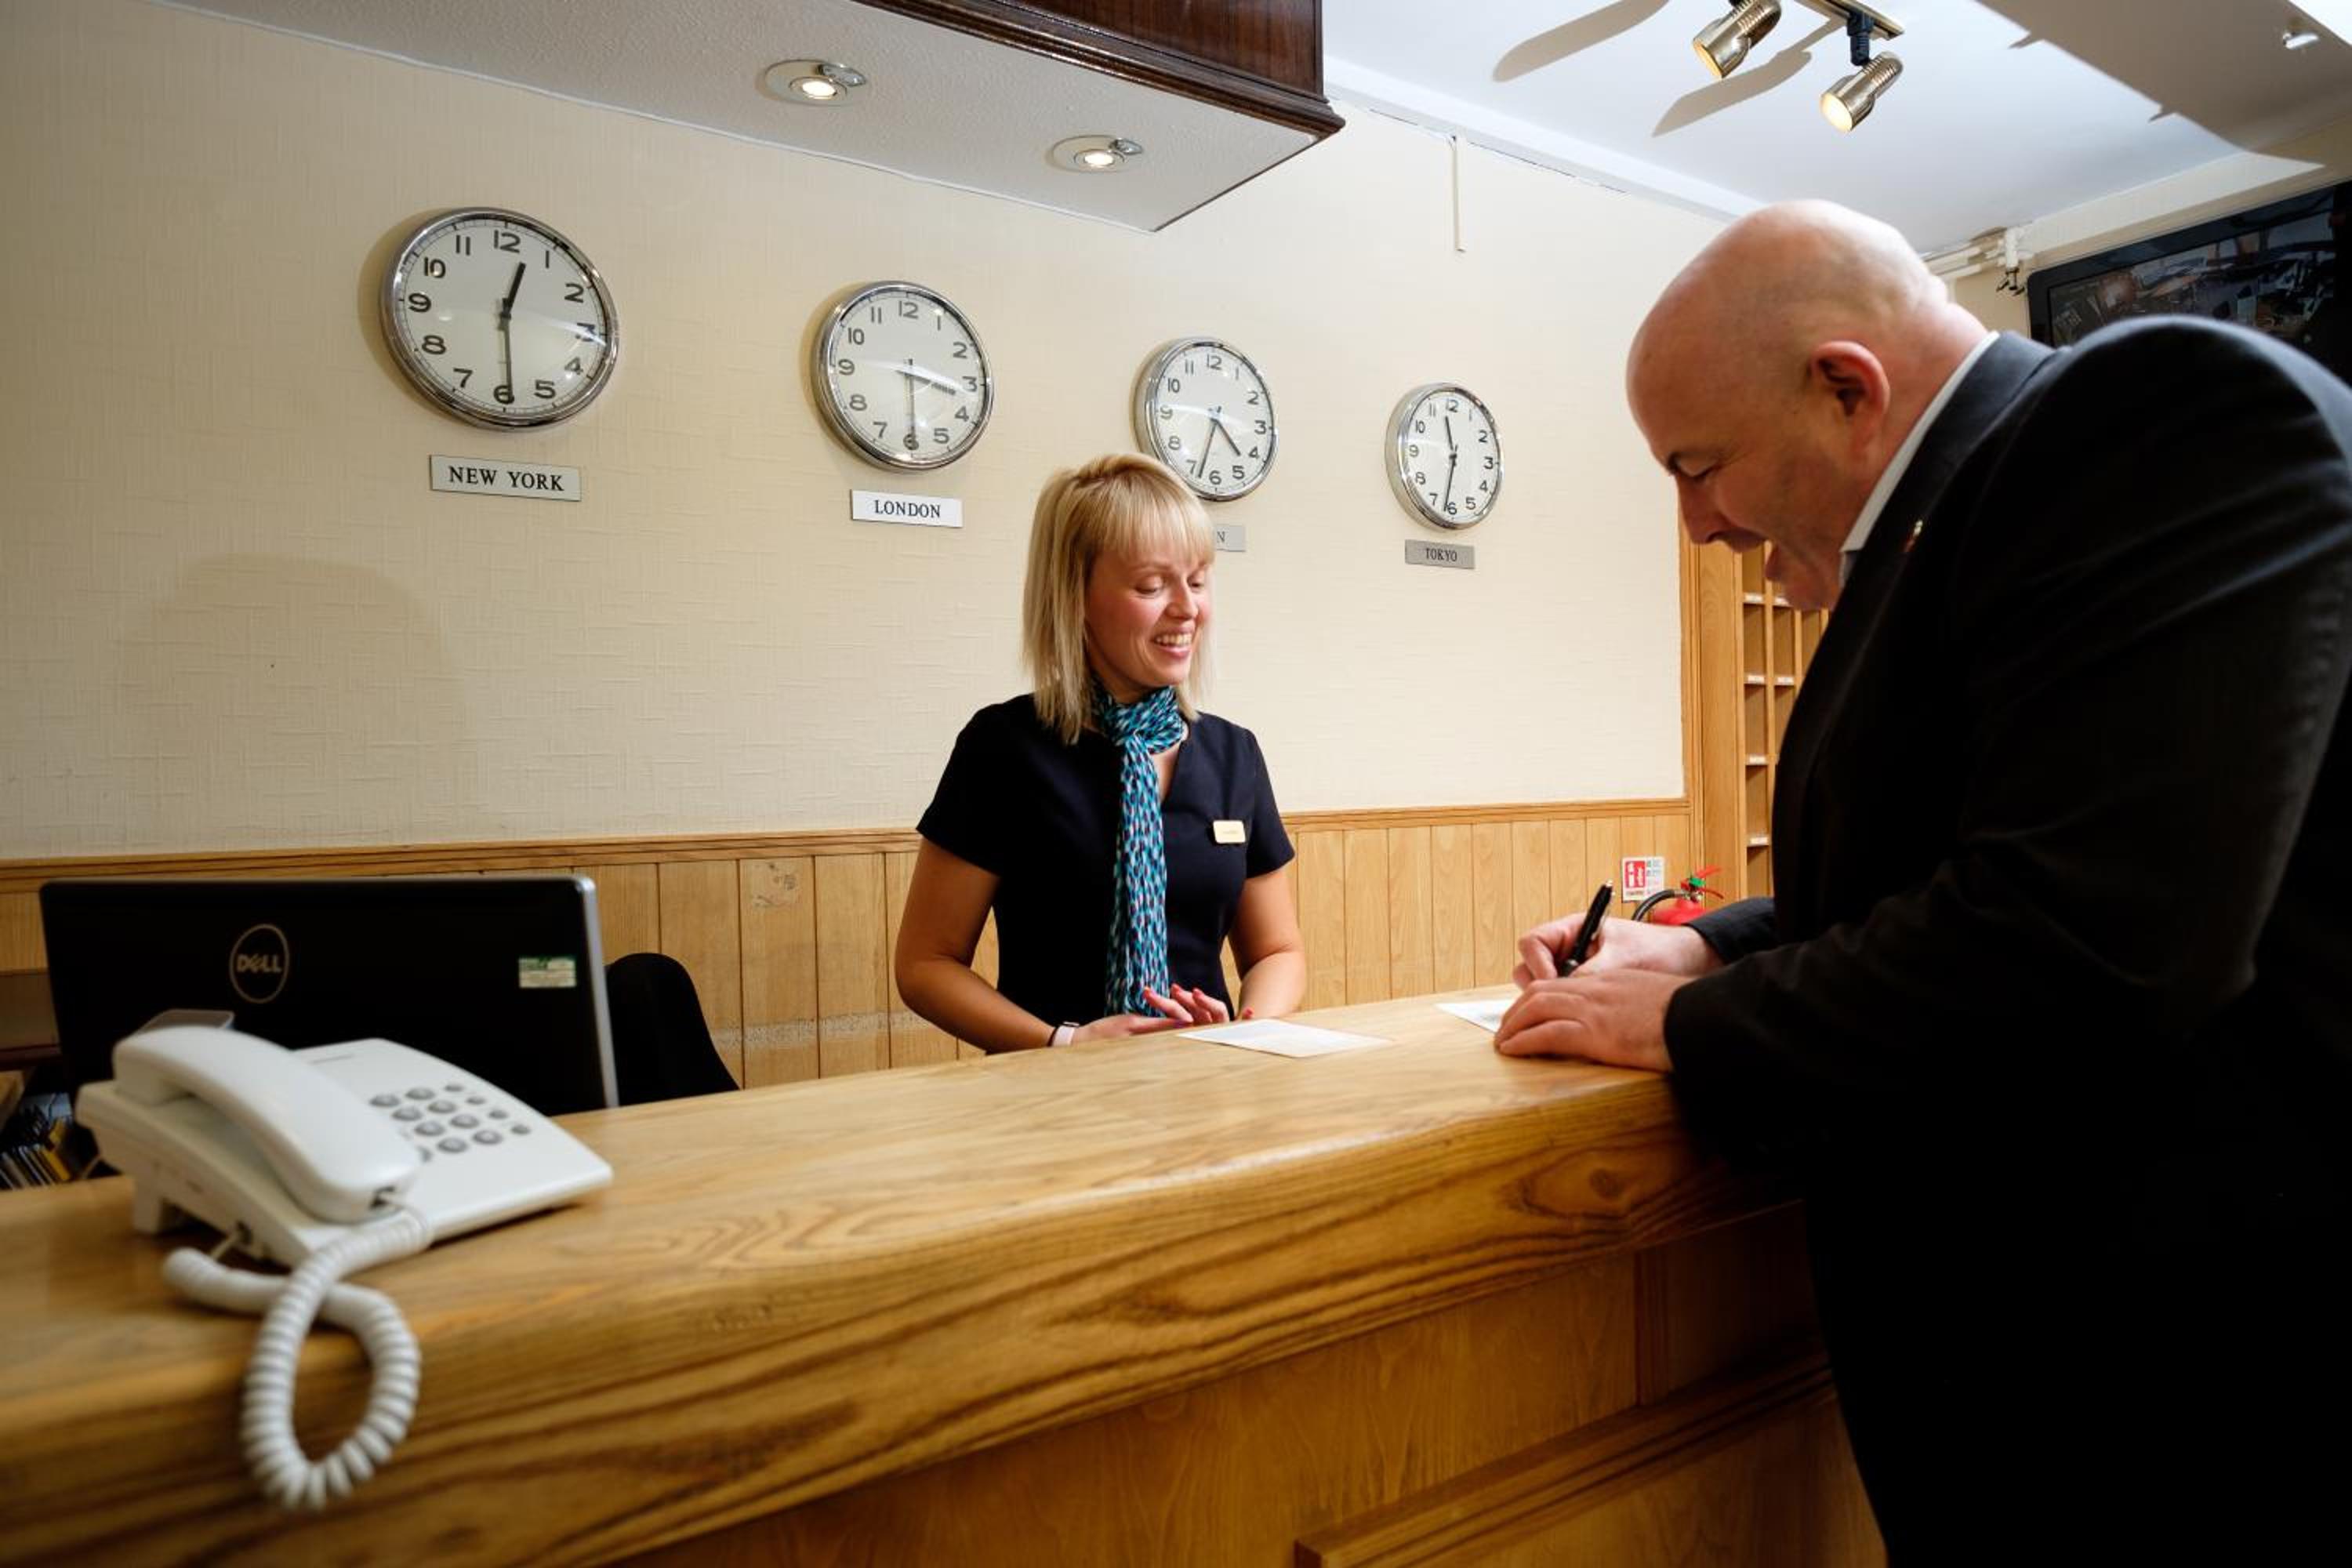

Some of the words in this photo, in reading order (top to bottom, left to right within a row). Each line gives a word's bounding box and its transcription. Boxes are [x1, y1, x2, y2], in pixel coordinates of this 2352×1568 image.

[456, 235, 470, 255] 11
[494, 230, 521, 252] 12
[424, 257, 446, 278] 10
[564, 283, 585, 303] 2
[408, 292, 431, 312] 9
[898, 300, 919, 318] 12
[871, 307, 881, 324] 11
[575, 322, 595, 342] 3
[848, 328, 865, 345] 10
[422, 336, 446, 355] 8
[953, 342, 967, 359] 2
[564, 358, 584, 376] 4
[838, 359, 855, 375] 9
[1185, 359, 1193, 375] 11
[1207, 354, 1221, 370] 12
[453, 368, 473, 388] 7
[963, 376, 978, 392] 3
[1167, 379, 1180, 393] 10
[494, 385, 514, 405] 6
[535, 380, 556, 399] 5
[849, 394, 867, 411] 8
[1247, 391, 1259, 405] 2
[1446, 400, 1459, 412] 12
[955, 406, 969, 422] 4
[1160, 407, 1173, 419] 9
[1429, 403, 1436, 417] 11
[873, 422, 887, 437] 7
[1254, 420, 1266, 434] 3
[1415, 420, 1425, 433] 10
[903, 434, 919, 450] 6
[934, 428, 949, 444] 5
[1168, 436, 1181, 450] 8
[1479, 430, 1487, 442] 2
[1249, 447, 1259, 459] 4
[1410, 445, 1418, 457] 9
[1186, 460, 1197, 474] 7
[1484, 457, 1494, 470] 3
[449, 466, 496, 486] NEW
[508, 471, 564, 491] YORK
[1209, 470, 1221, 485] 6
[1232, 465, 1245, 480] 5
[1415, 472, 1426, 485] 8
[1479, 480, 1488, 492] 4
[1429, 493, 1438, 506] 7
[1466, 497, 1475, 510] 5
[875, 500, 941, 517] LONDON
[1446, 503, 1457, 515] 6
[1425, 548, 1457, 561] TOKYO
[237, 953, 281, 973] DELL
